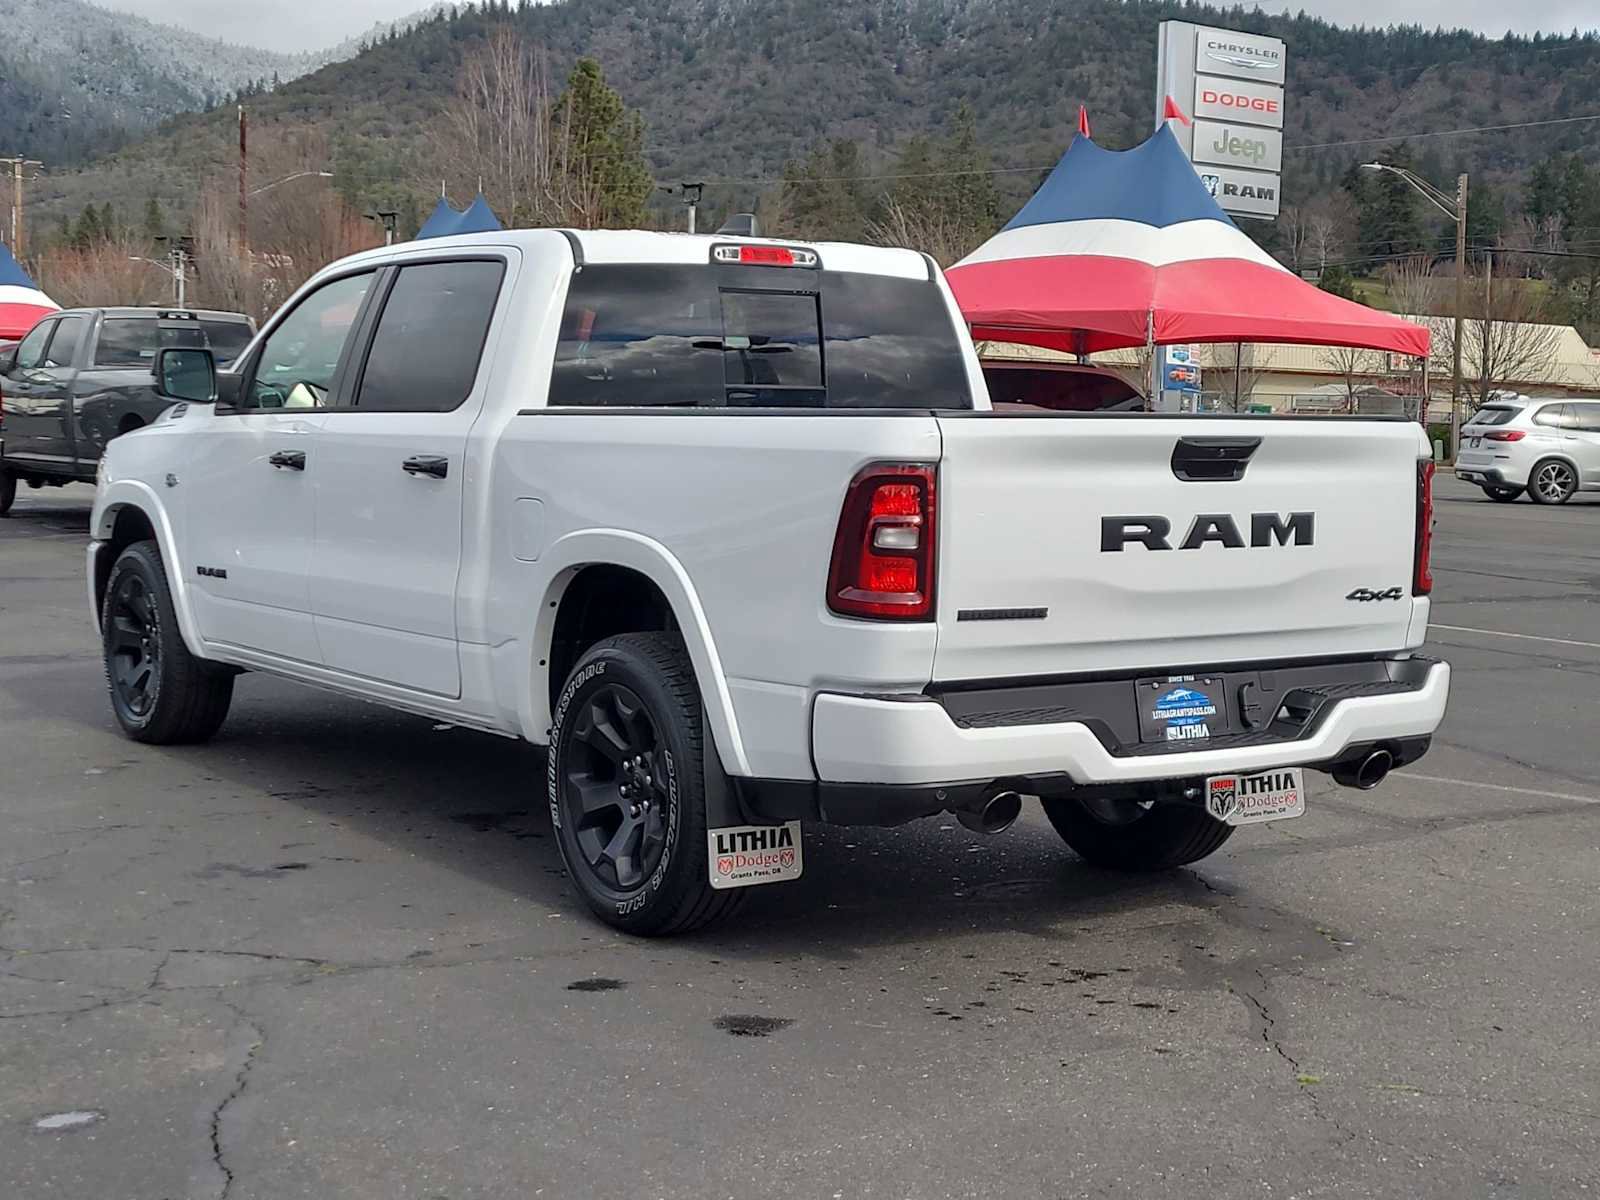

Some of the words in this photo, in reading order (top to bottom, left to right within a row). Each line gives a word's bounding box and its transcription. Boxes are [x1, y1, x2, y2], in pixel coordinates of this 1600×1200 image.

[1207, 42, 1279, 59] CHRYSLER
[1202, 91, 1278, 112] DODGE
[1213, 129, 1266, 163] Jeep
[1223, 183, 1275, 200] RAM
[1100, 511, 1315, 552] RAM
[1345, 586, 1404, 601] 4x4
[1177, 723, 1210, 738] LITHIA
[1238, 772, 1296, 795] ITHIA
[1247, 794, 1285, 808] Dodge
[717, 828, 793, 854] LITHIA
[736, 852, 779, 868] Dodge
